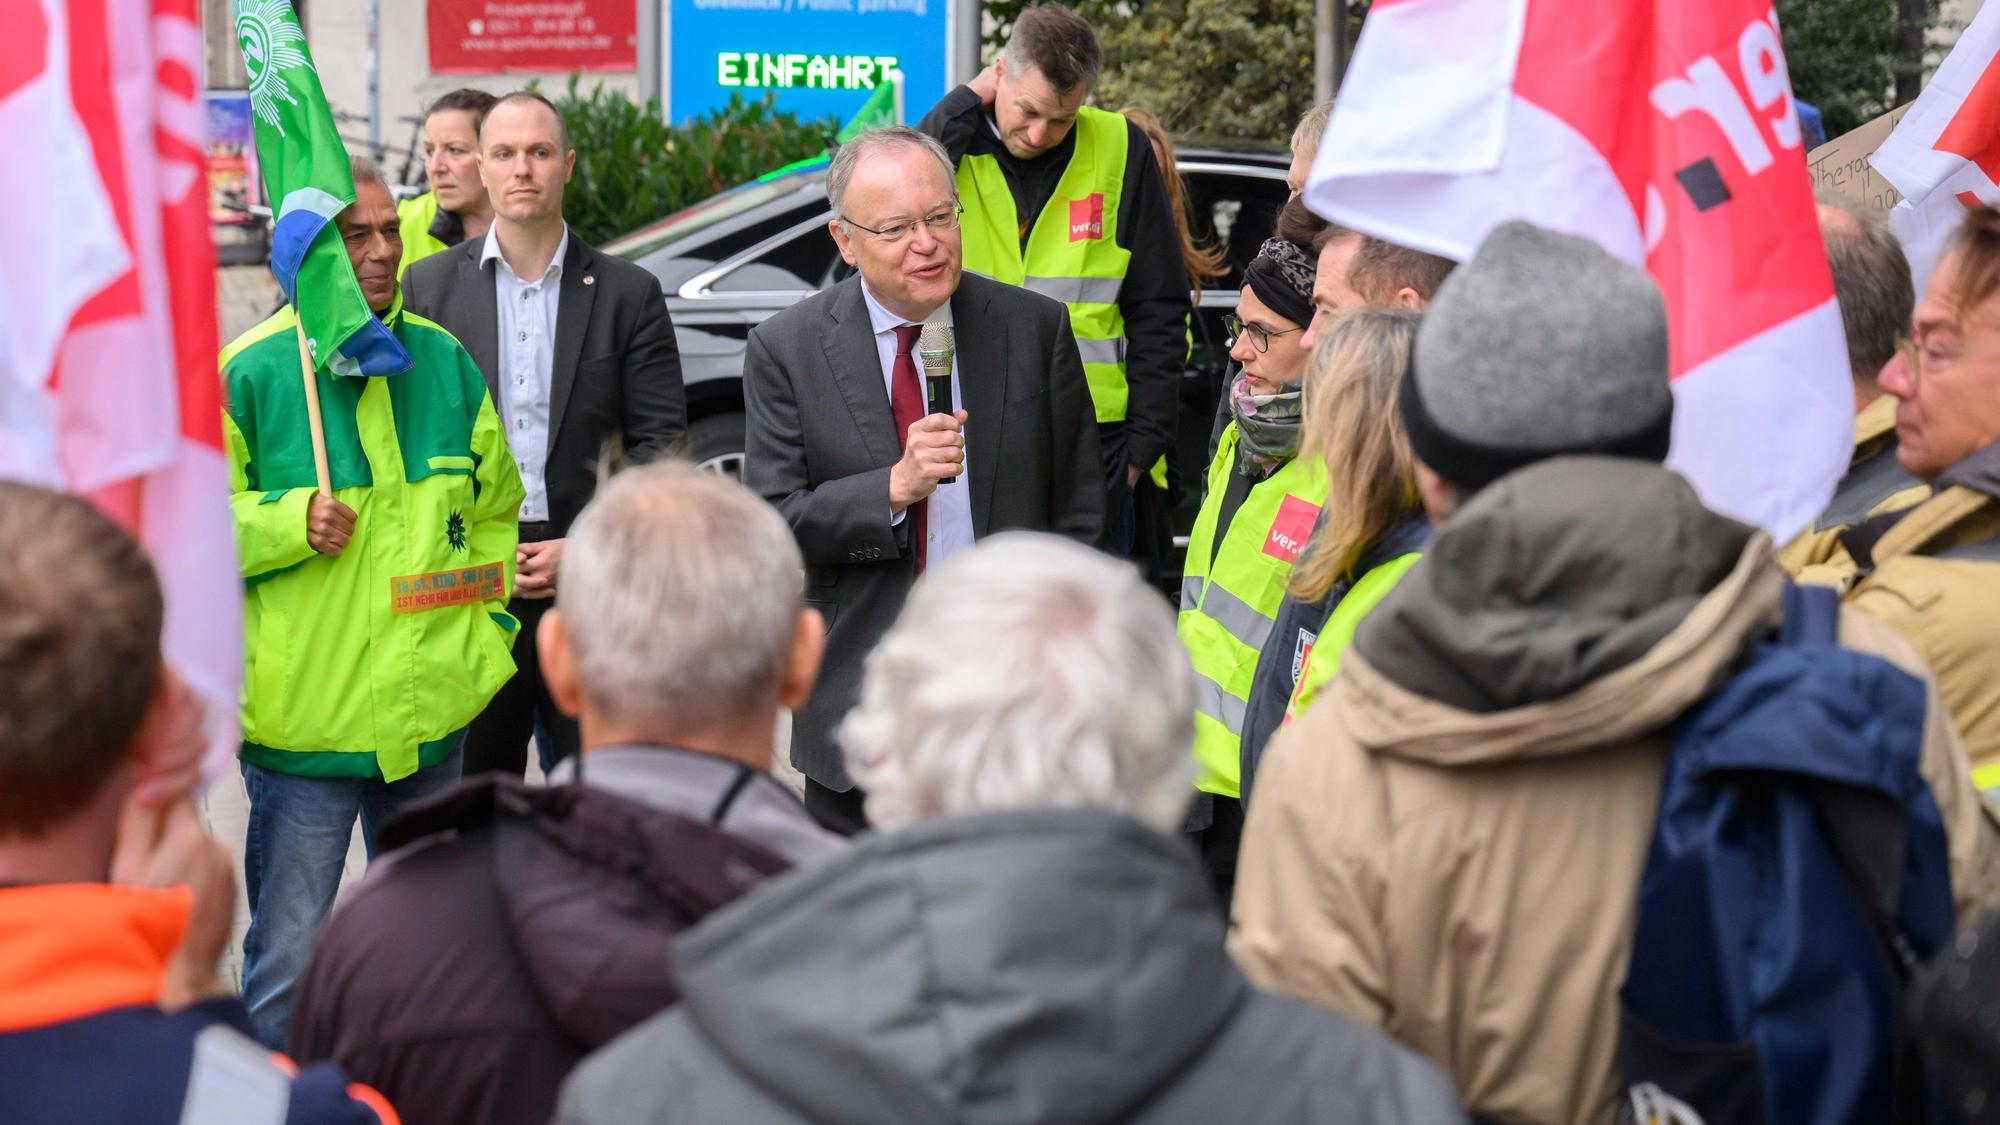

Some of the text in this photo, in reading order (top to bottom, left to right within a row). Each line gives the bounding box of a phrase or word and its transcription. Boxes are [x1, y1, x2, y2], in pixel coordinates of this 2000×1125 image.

[718, 52, 898, 90] EINFAHRT
[1071, 222, 1100, 234] ver.di
[397, 596, 413, 608] IST
[415, 593, 435, 606] MEHR
[436, 590, 450, 603] FÜR
